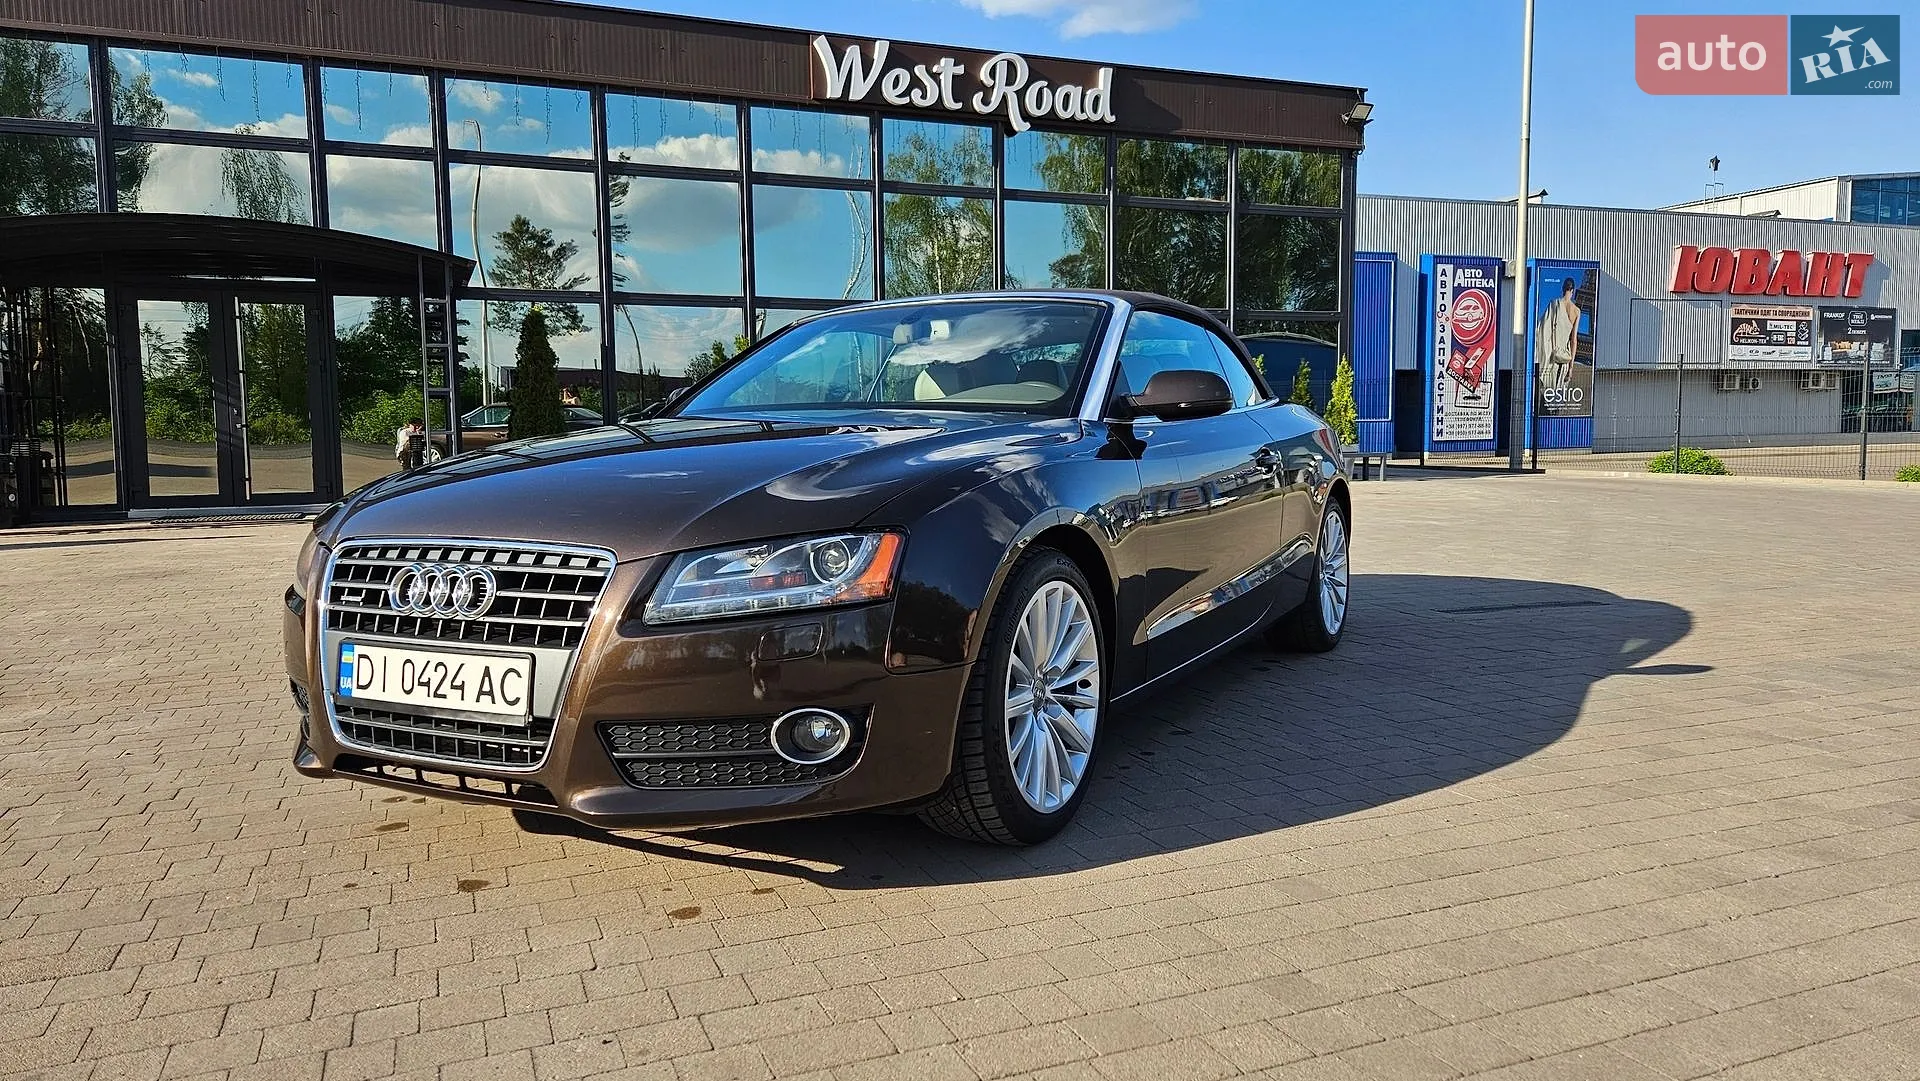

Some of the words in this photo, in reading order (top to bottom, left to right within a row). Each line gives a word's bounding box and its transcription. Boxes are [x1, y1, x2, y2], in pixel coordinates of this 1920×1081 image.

[813, 35, 964, 110] West
[972, 53, 1116, 132] Road
[1670, 245, 1874, 298] ЮВАНТ
[1544, 385, 1583, 402] estro
[356, 653, 387, 693] DI
[401, 658, 466, 701] 0424
[475, 665, 523, 706] AC
